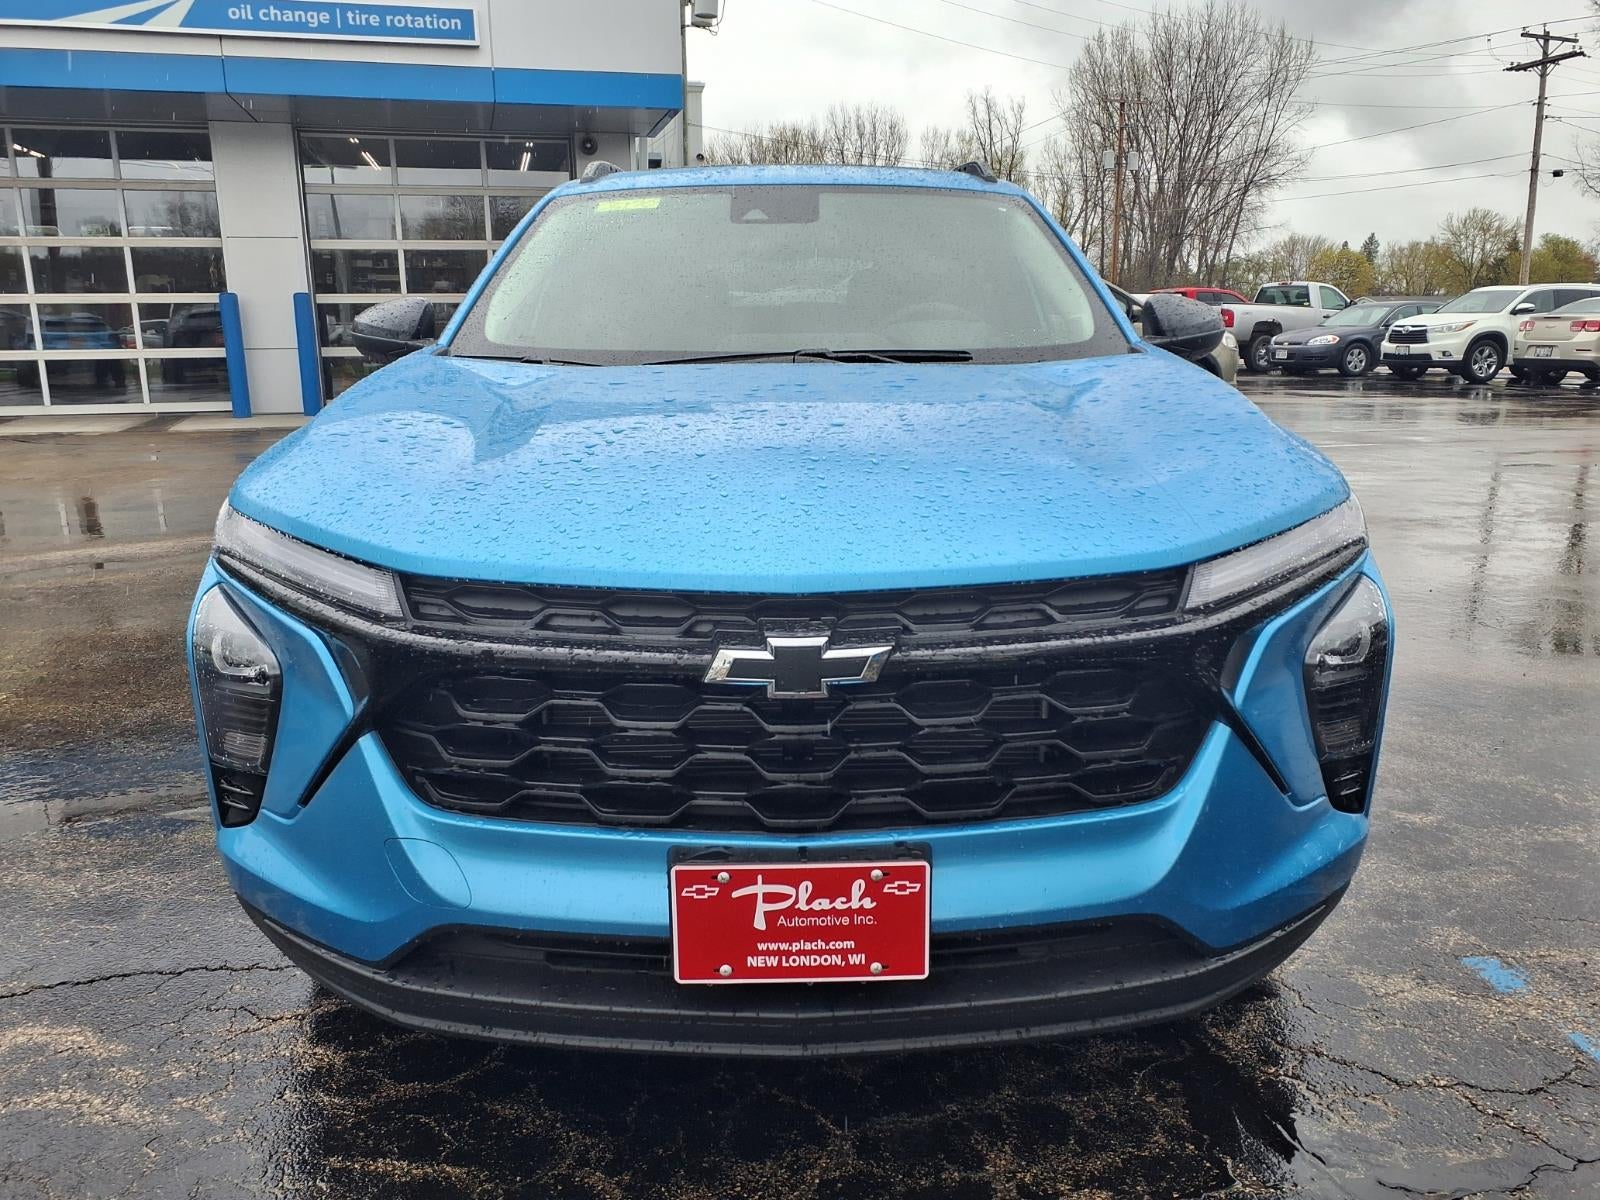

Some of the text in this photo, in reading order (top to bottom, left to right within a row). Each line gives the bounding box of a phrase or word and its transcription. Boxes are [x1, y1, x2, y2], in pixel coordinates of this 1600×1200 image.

[228, 4, 462, 30] oil change tire rotation
[731, 874, 877, 931] Plach
[777, 913, 878, 927] Automotive Inc.
[757, 939, 855, 952] www.plach.com
[747, 953, 866, 967] NEW LONDON, WI
